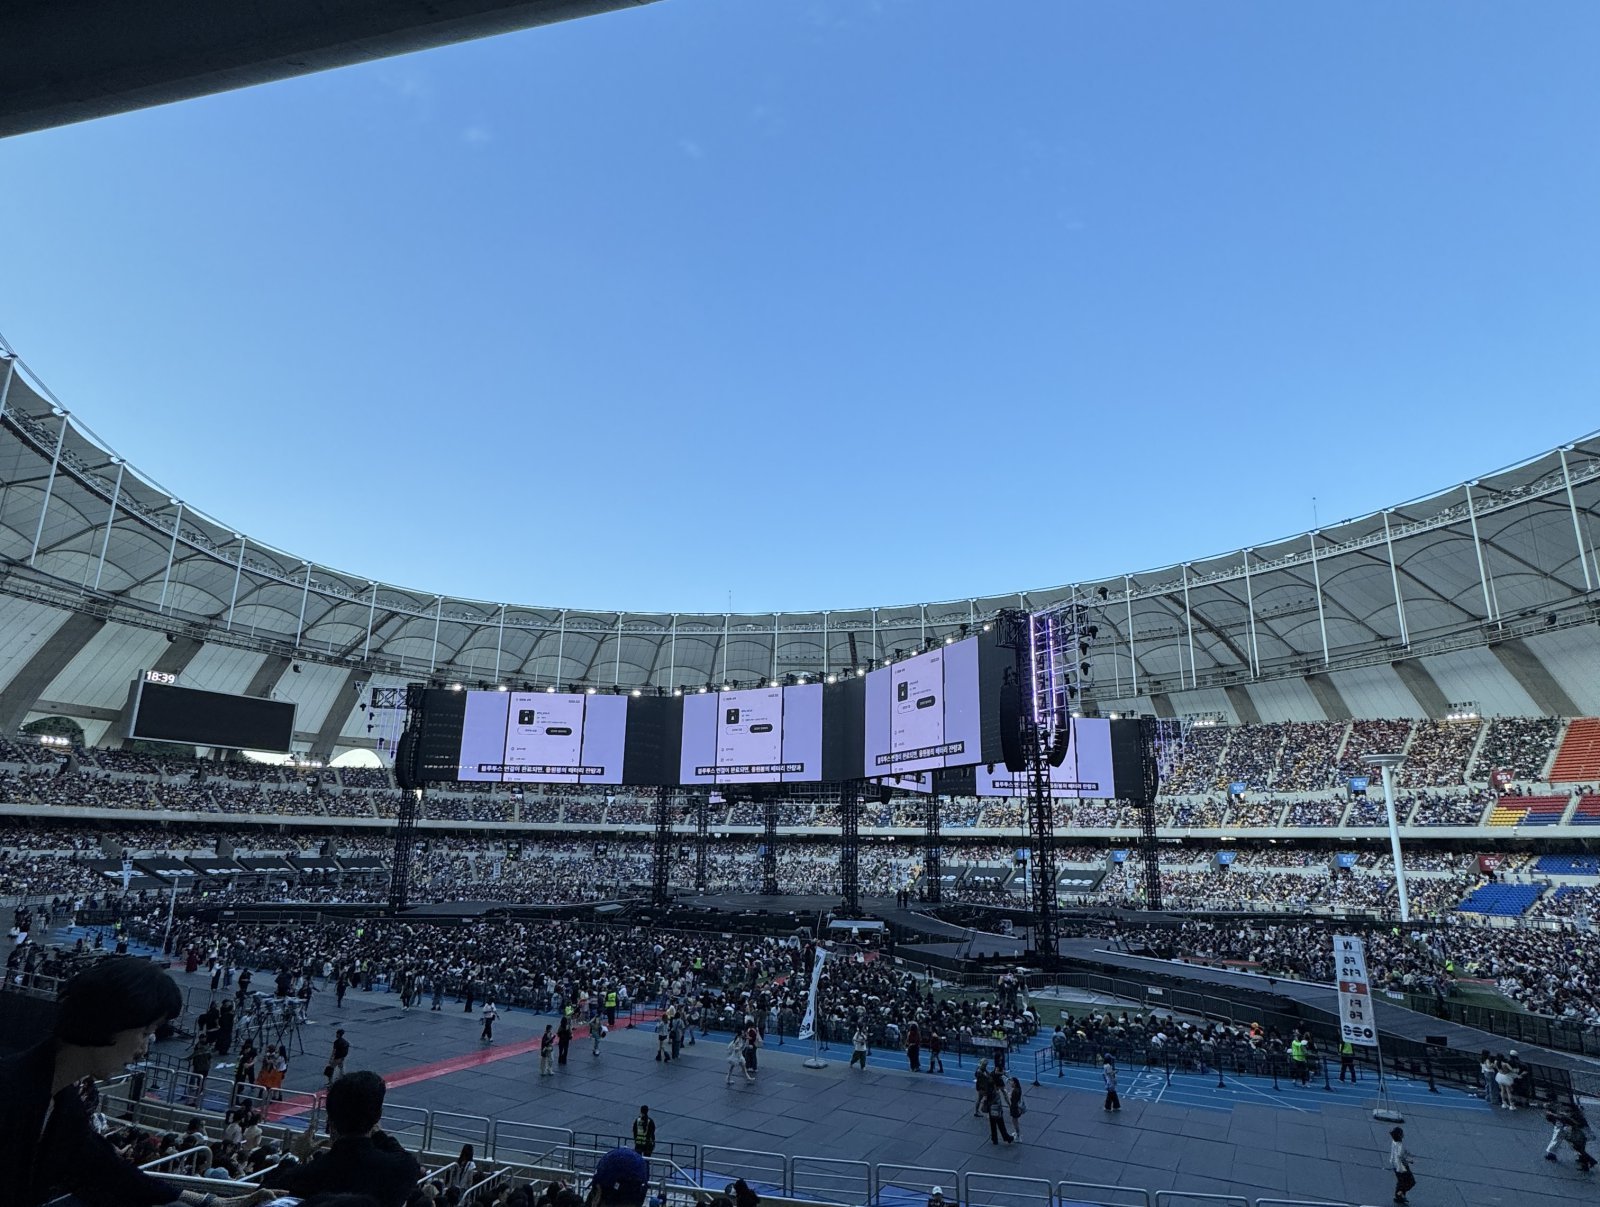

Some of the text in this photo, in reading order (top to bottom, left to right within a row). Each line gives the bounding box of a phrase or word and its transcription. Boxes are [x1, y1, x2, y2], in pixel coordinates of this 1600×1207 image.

[147, 671, 175, 684] 18:39
[585, 767, 602, 775] 잔량과
[697, 767, 715, 775] 블루투스
